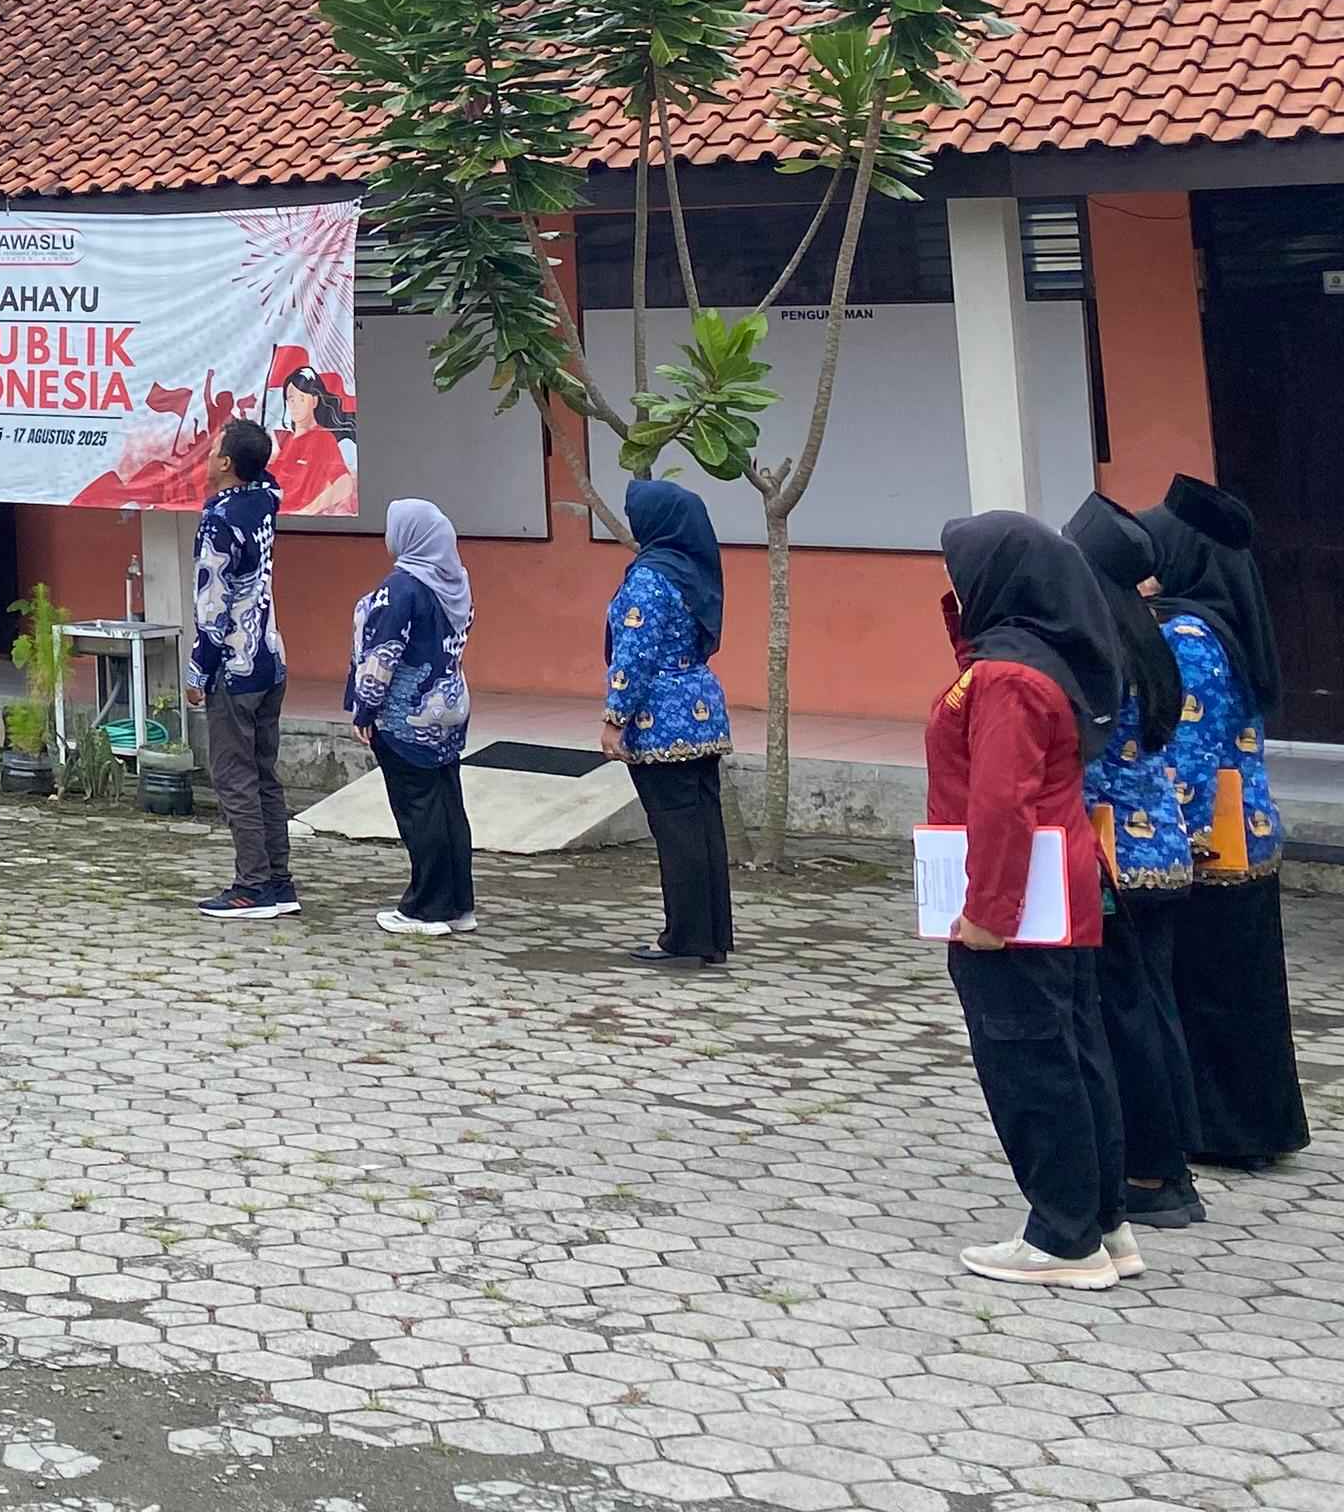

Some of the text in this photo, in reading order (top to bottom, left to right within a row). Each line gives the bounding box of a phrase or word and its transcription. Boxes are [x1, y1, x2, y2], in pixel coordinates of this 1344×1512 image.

[781, 309, 874, 320] PENGUMAN
[13, 427, 27, 444] 17
[27, 428, 75, 445] AGUSTUS
[77, 430, 109, 447] 2025
